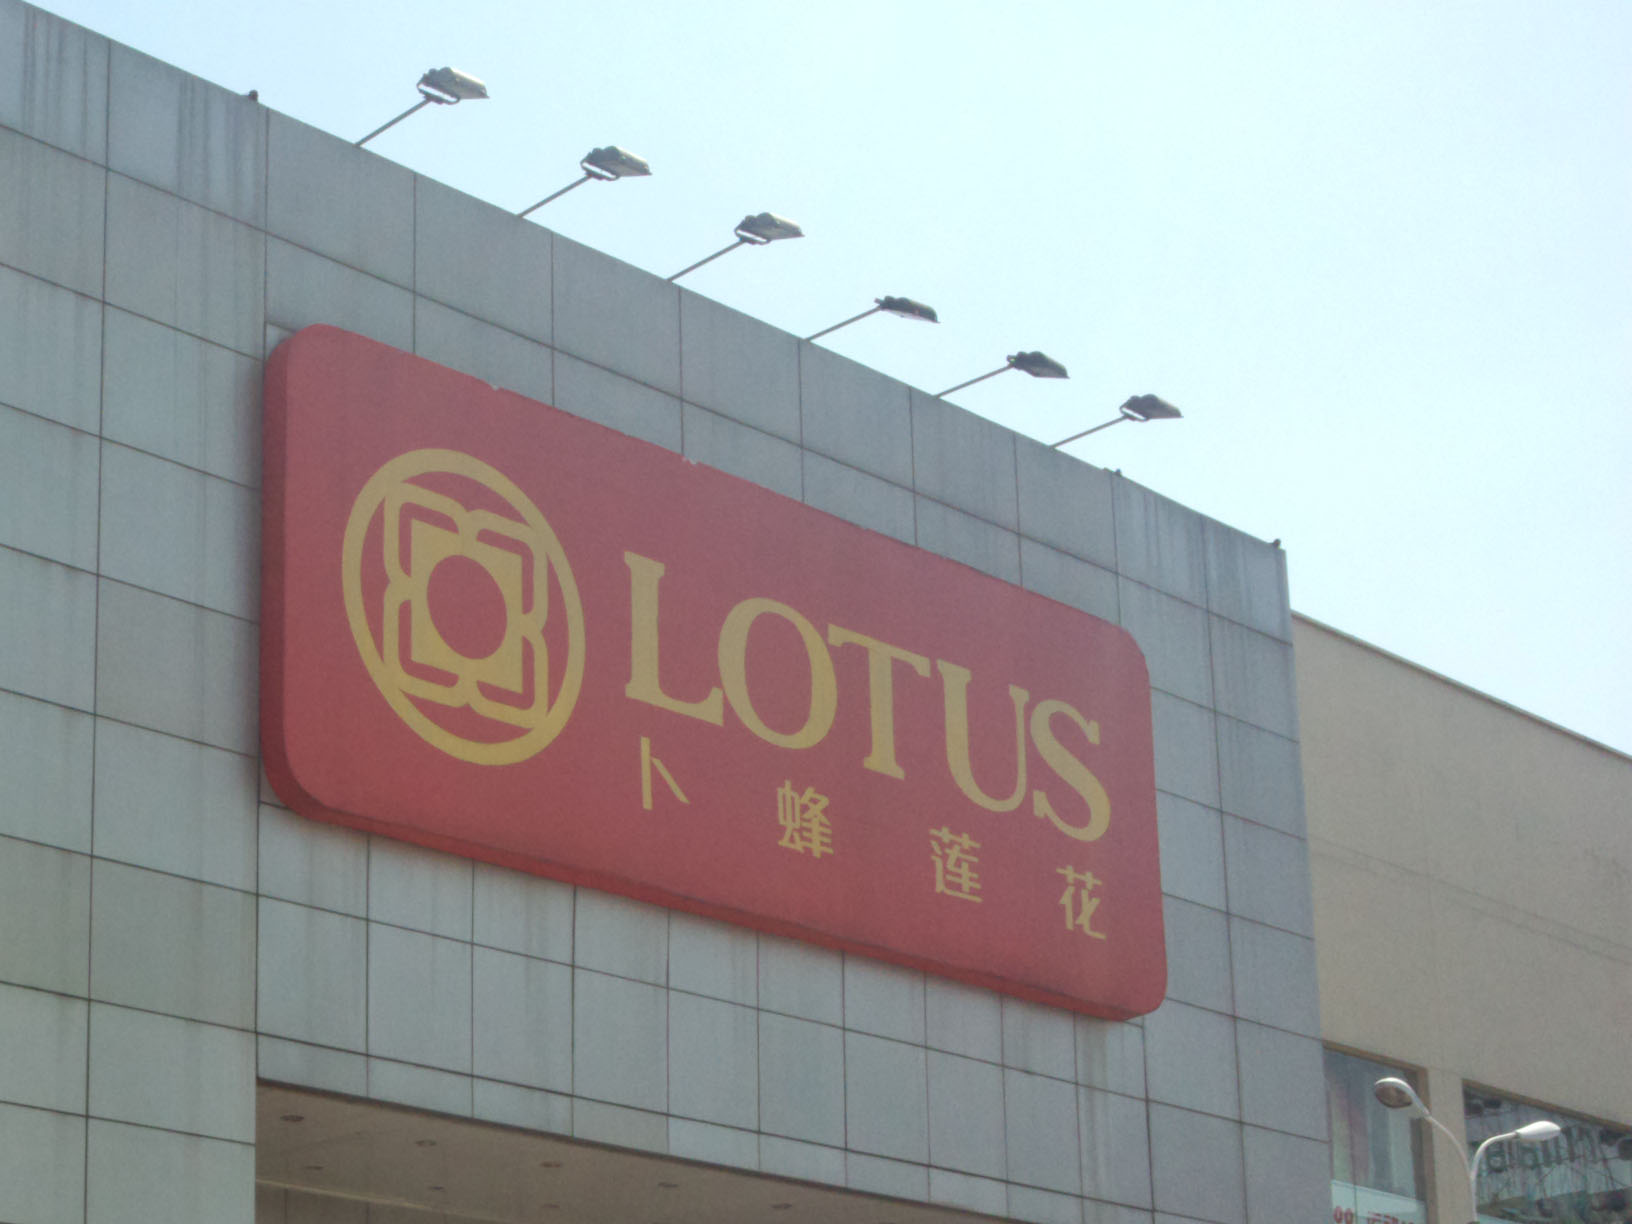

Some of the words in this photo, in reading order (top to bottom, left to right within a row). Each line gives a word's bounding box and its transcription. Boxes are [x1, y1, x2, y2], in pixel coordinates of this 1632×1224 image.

[624, 550, 1112, 842] LOTUS
[639, 735, 1107, 941] 卜蜂莲花
